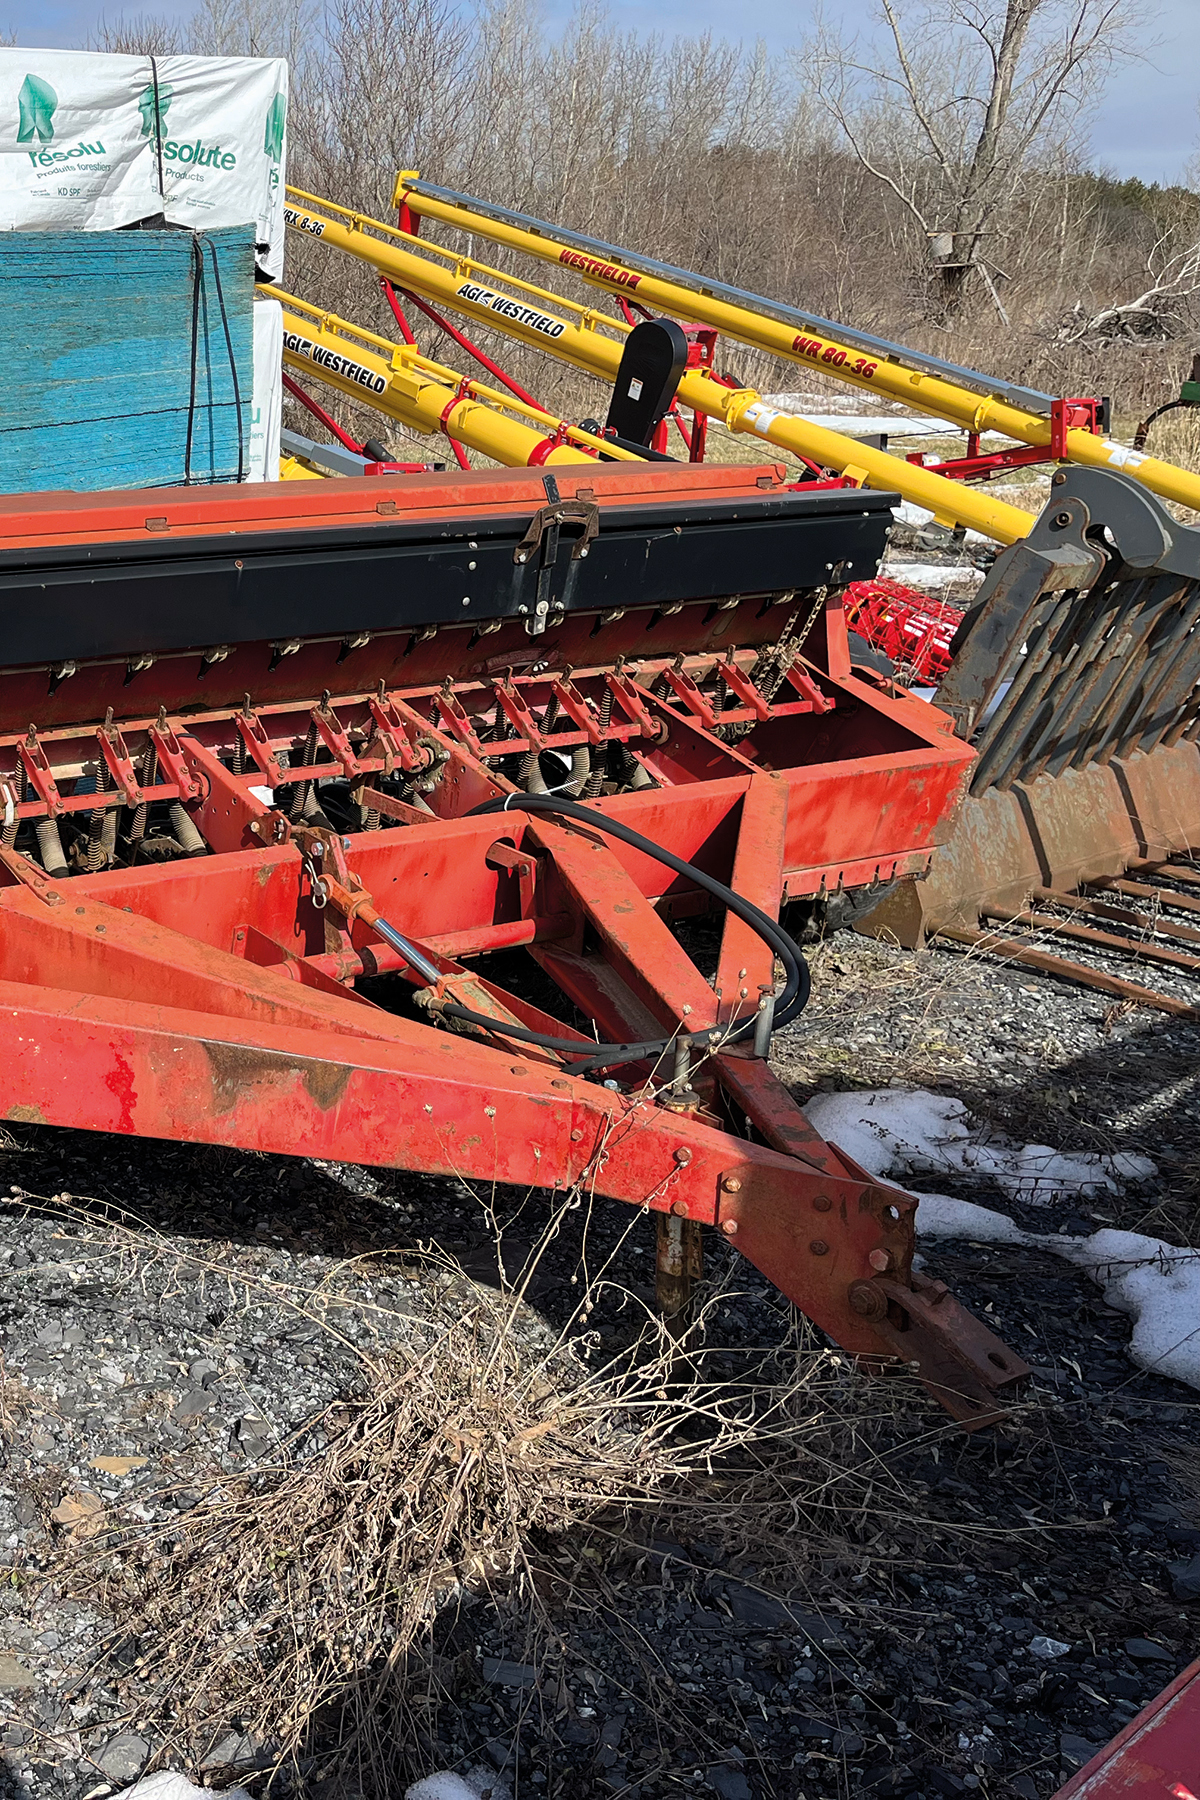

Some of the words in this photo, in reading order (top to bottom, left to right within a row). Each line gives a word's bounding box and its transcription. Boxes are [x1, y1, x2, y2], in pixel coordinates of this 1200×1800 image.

[28, 140, 106, 168] résolu
[36, 165, 77, 179] Produits
[76, 162, 111, 172] forestiers
[165, 167, 205, 182] Products
[58, 187, 68, 196] KD
[69, 187, 81, 197] SPF
[300, 216, 325, 236] 8-36
[559, 248, 630, 286] WESTFIELD
[457, 283, 485, 302] AGI
[491, 296, 565, 338] WESTFIELD
[312, 345, 386, 394] WESTFIELD
[792, 335, 823, 359] WR
[821, 347, 878, 378] 80-36
